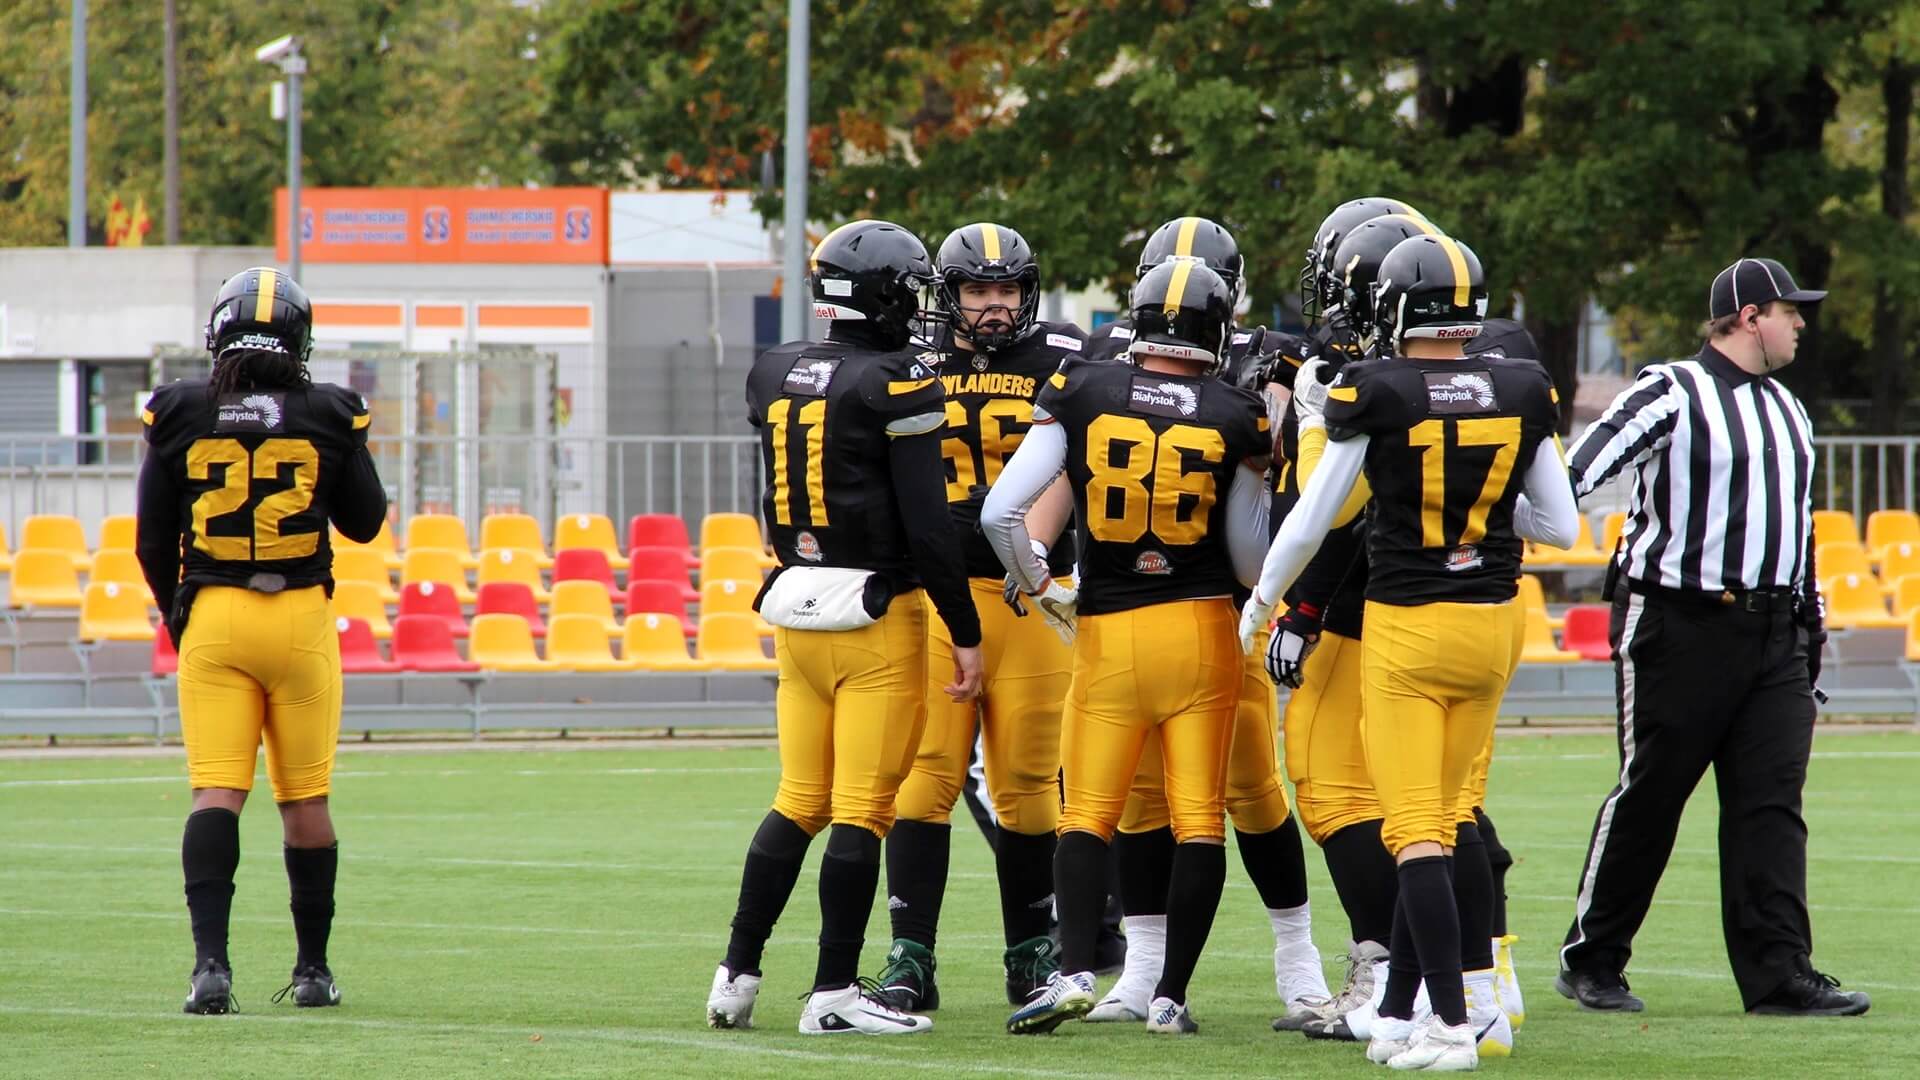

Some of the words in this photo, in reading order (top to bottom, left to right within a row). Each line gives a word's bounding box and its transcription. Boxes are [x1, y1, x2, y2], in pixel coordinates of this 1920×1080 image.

[242, 333, 280, 346] schutt
[939, 372, 1036, 398] WLANDERS
[186, 438, 319, 561] 22
[766, 399, 831, 527] 11
[1086, 413, 1226, 546] 86
[1408, 416, 1522, 548] 17
[1156, 1003, 1178, 1026] NIKE
